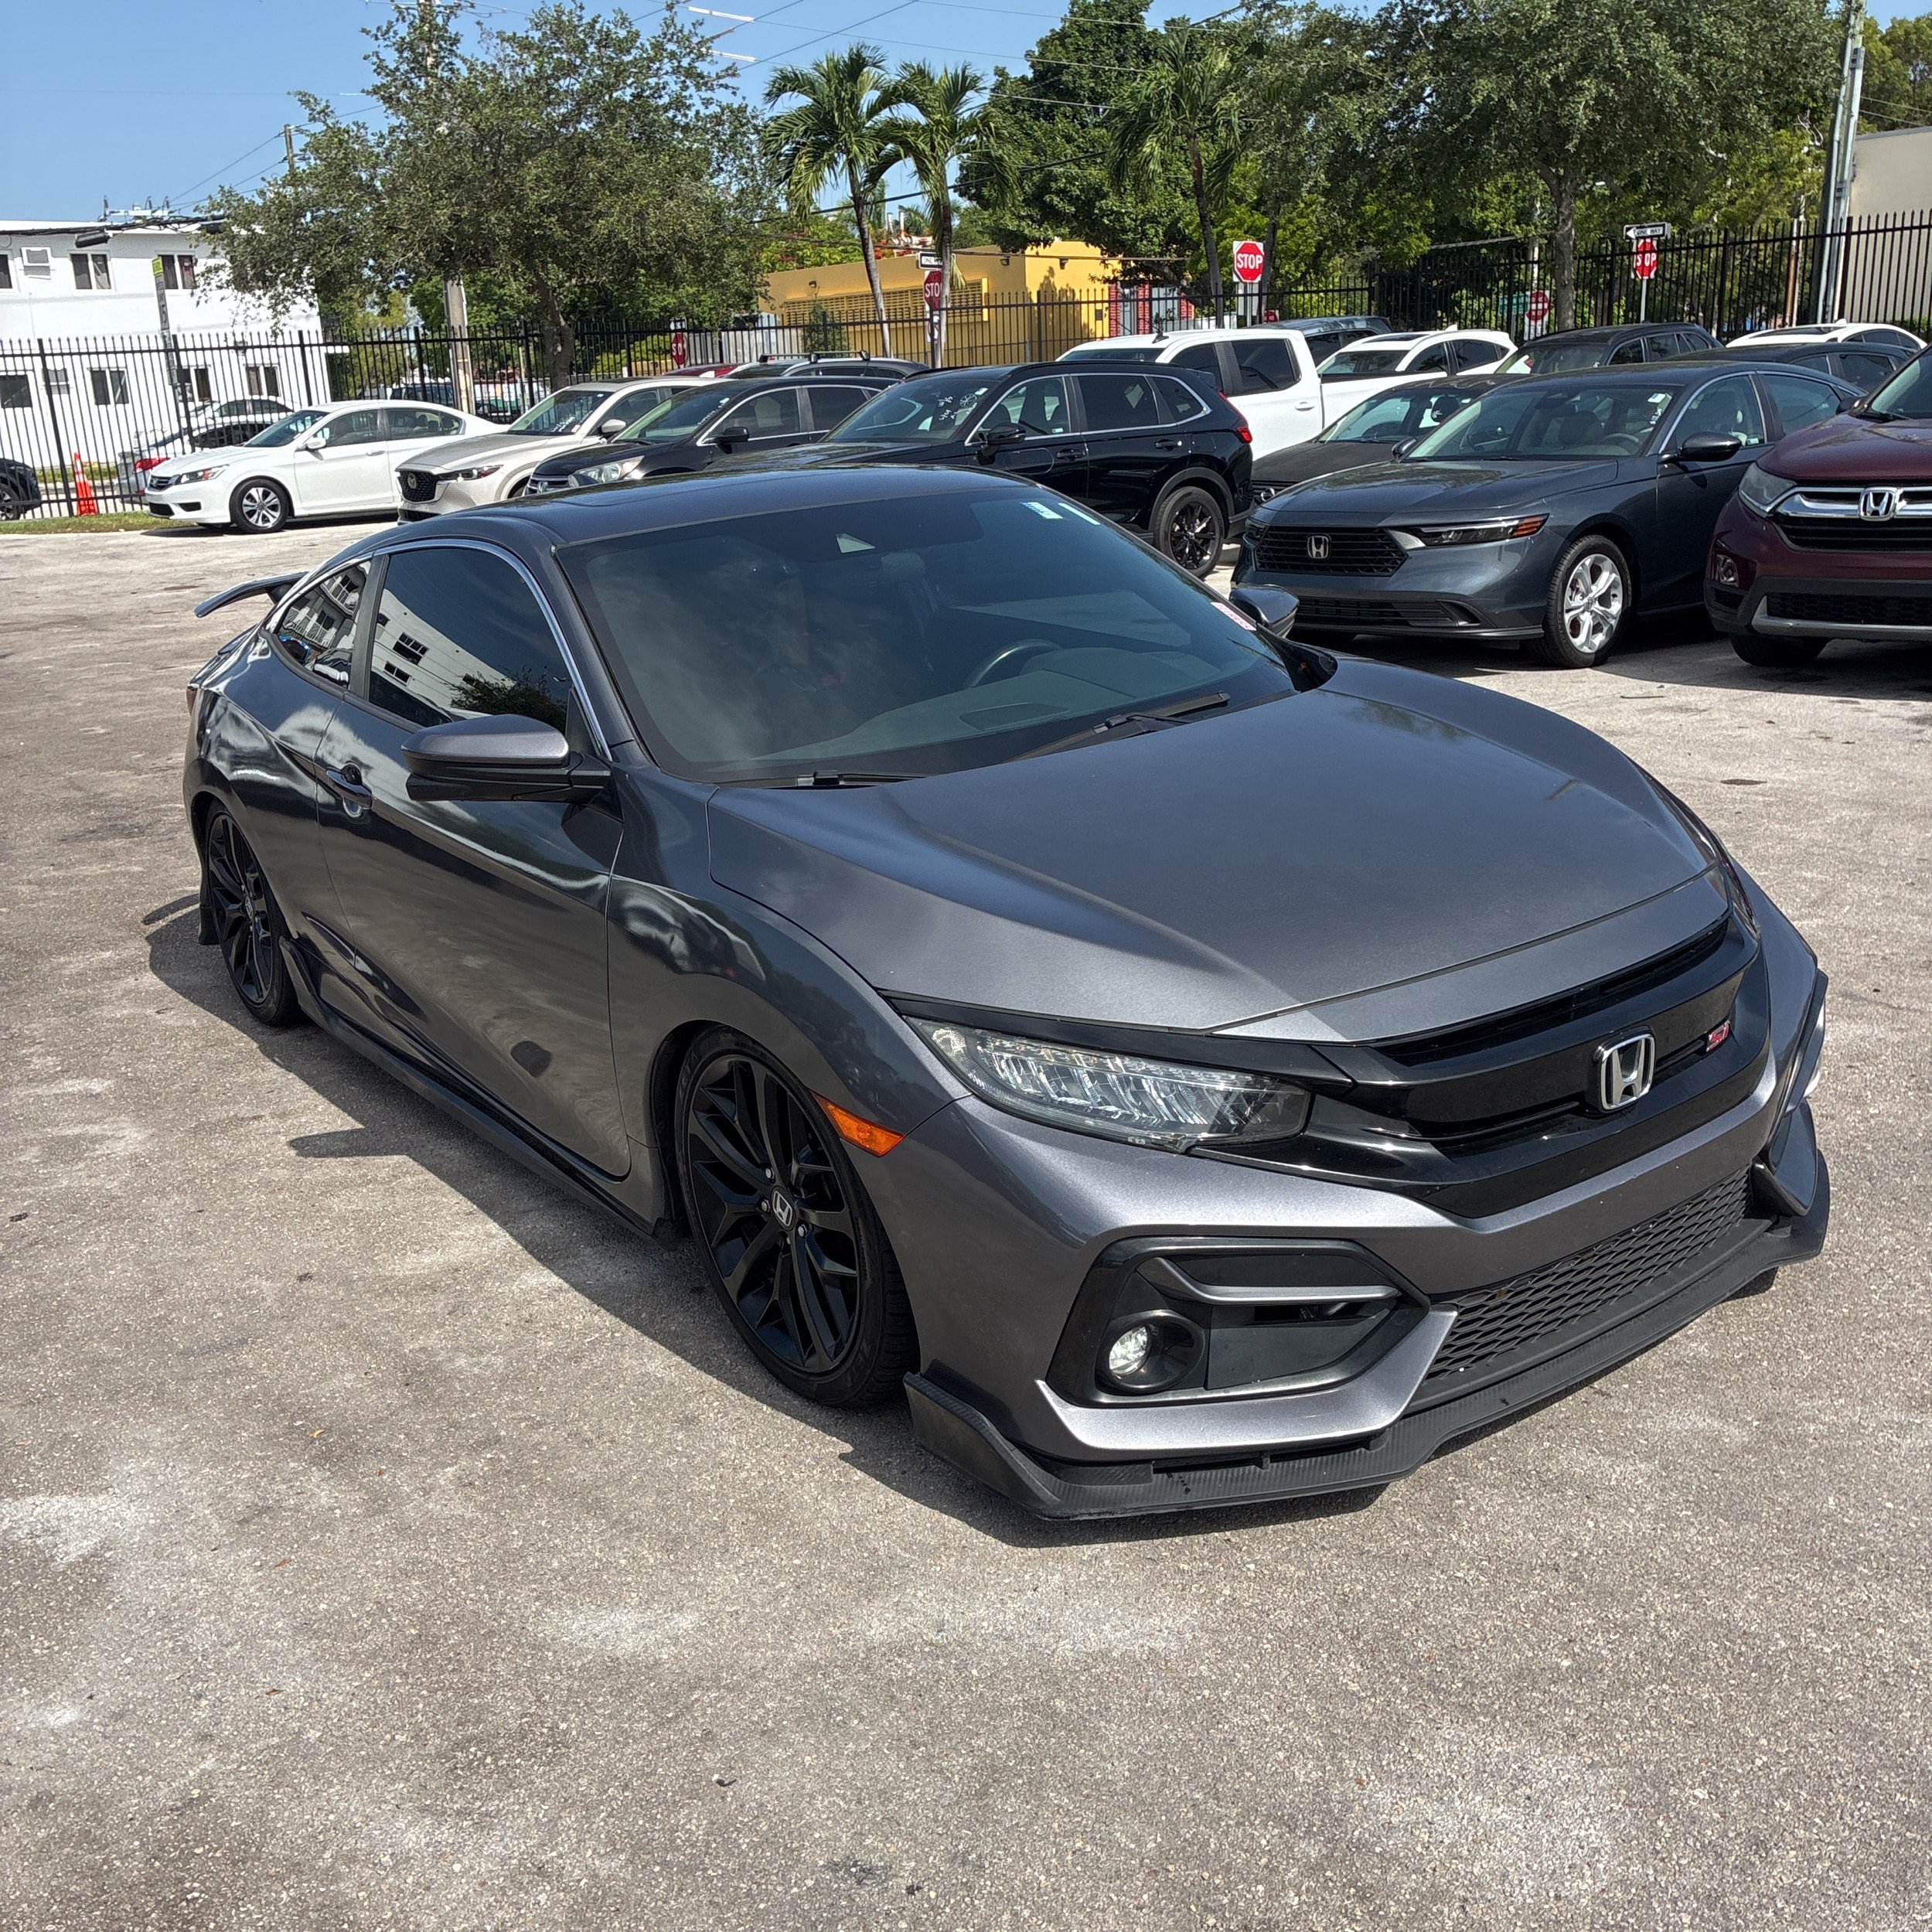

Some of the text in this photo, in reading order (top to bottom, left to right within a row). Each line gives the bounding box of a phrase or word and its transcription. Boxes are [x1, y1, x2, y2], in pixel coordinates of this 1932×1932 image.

[1237, 253, 1263, 269] STOP
[1636, 252, 1657, 267] SOP
[925, 282, 942, 298] STO
